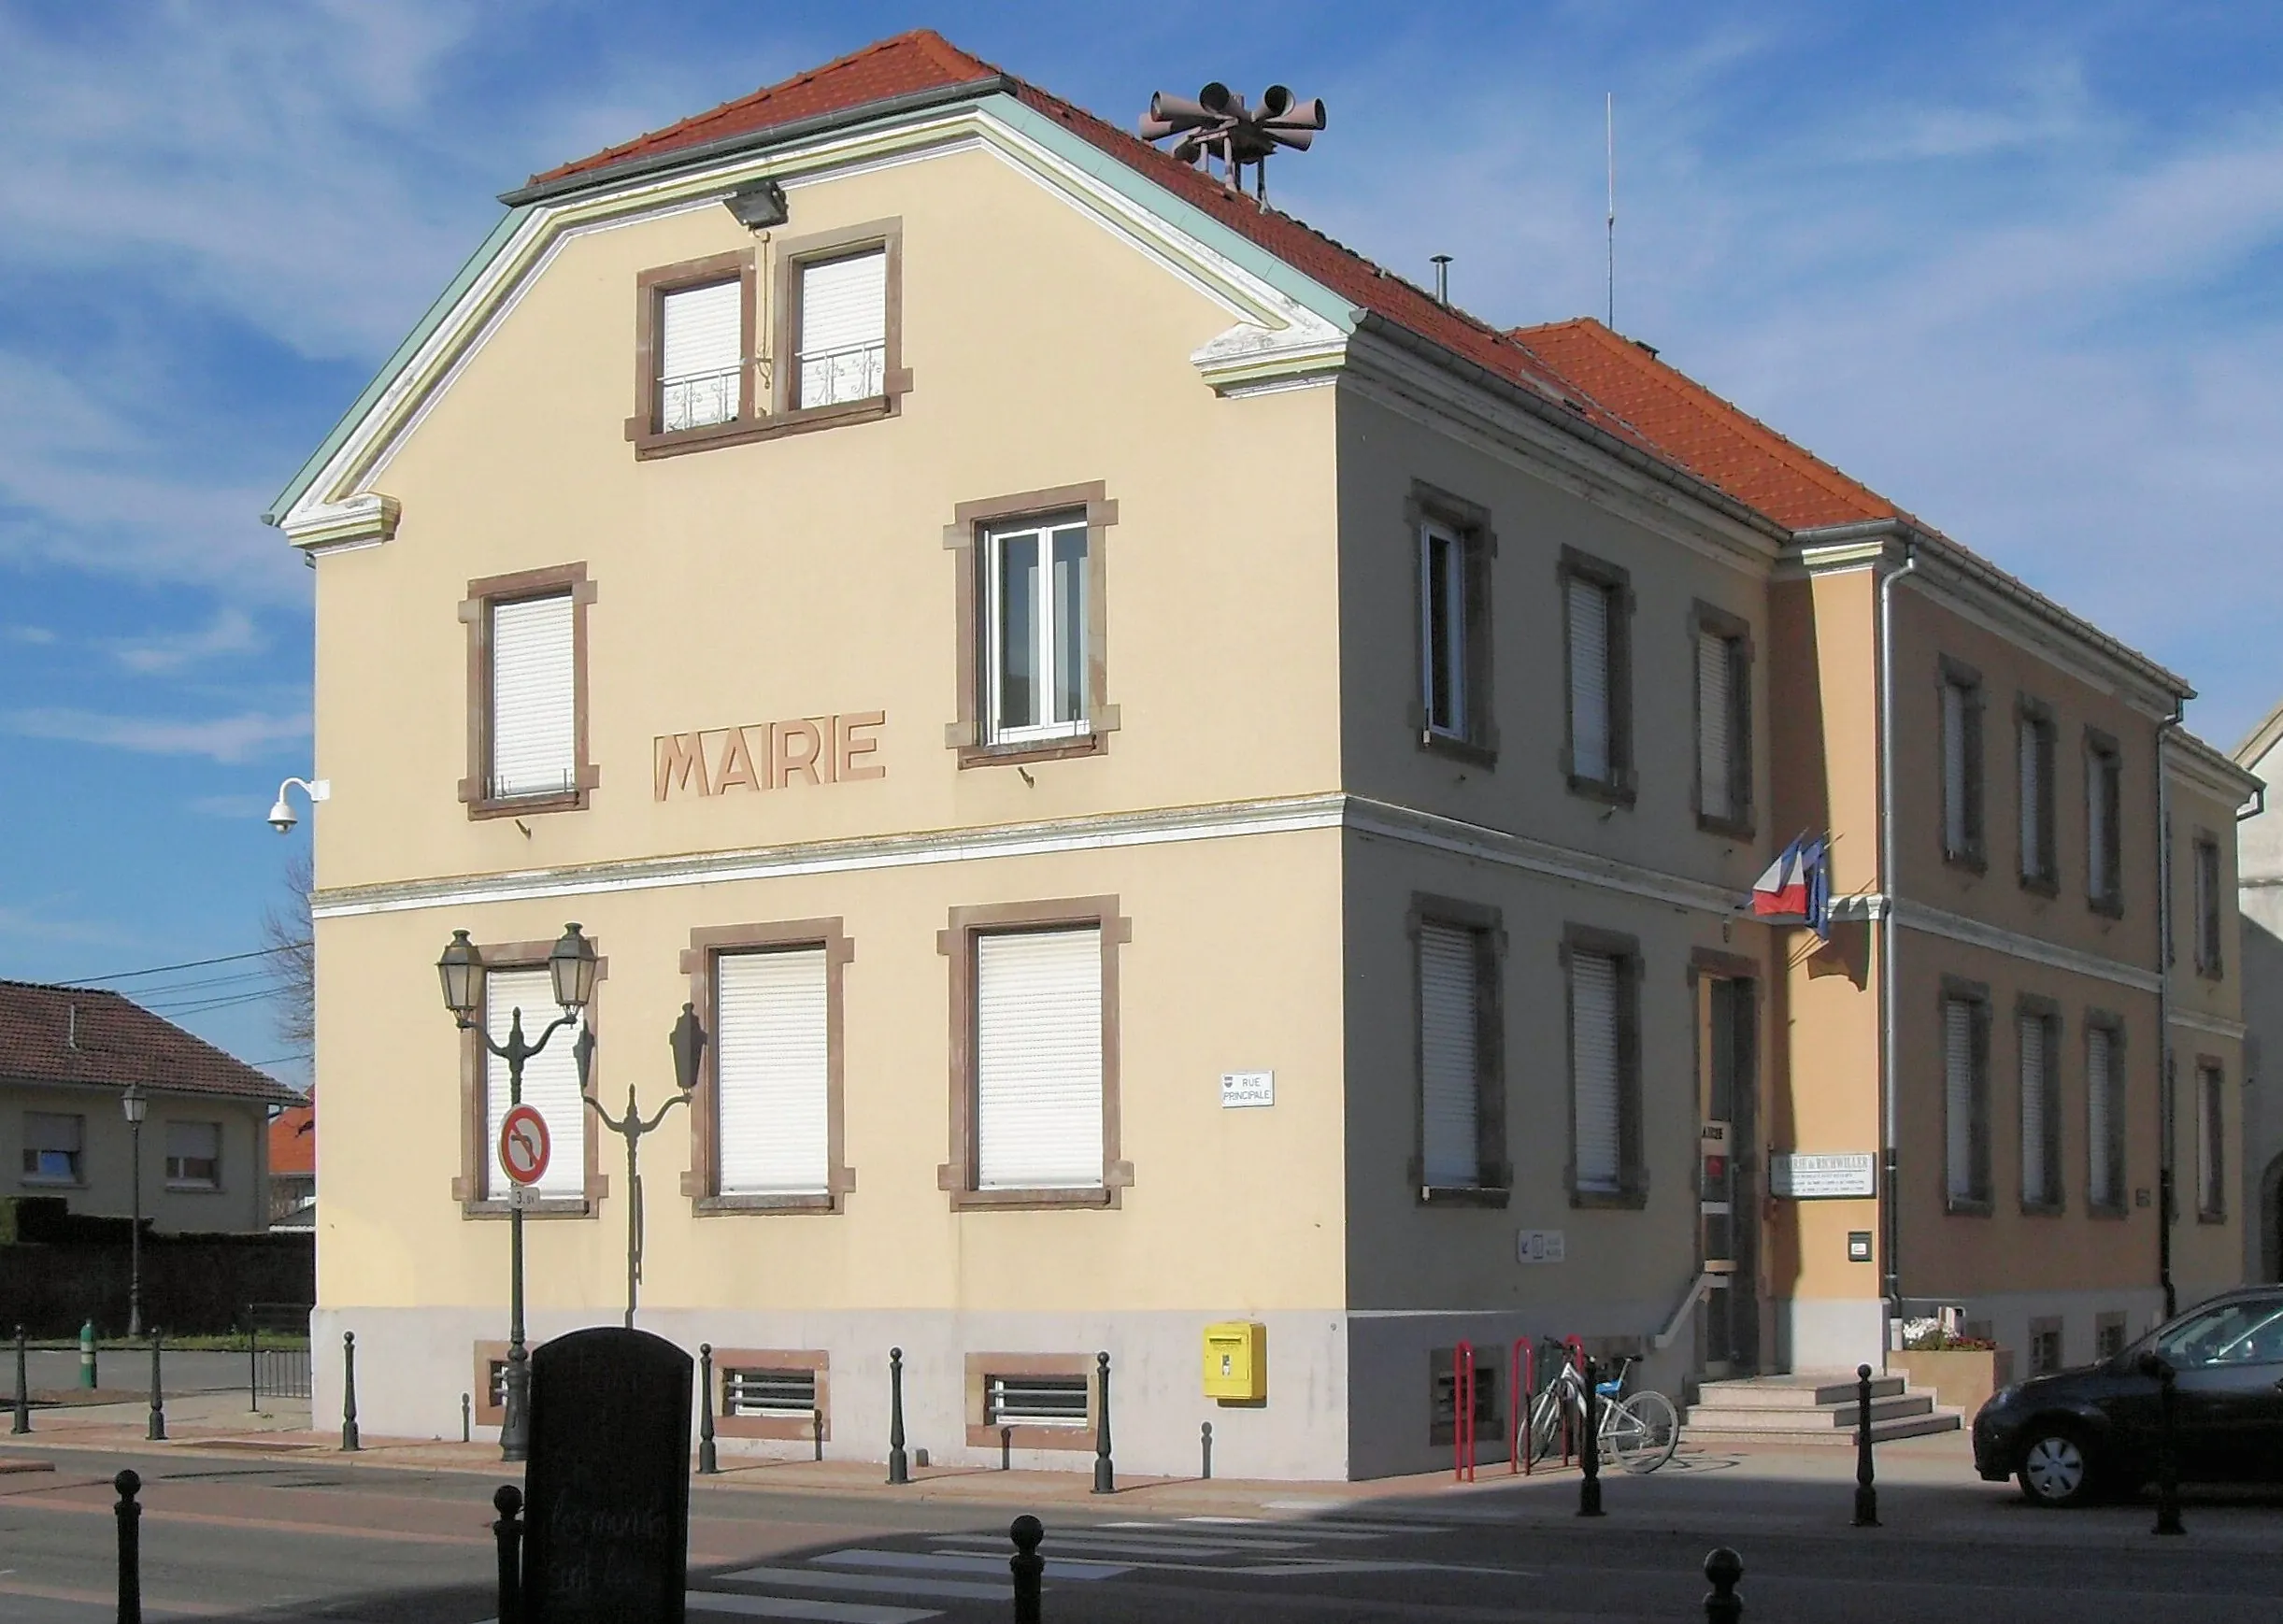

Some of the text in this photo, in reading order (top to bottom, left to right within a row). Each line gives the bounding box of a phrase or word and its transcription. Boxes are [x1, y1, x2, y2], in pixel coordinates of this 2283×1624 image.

[653, 709, 886, 802] MAIRIE
[1242, 1076, 1262, 1088] RUE
[1223, 1090, 1271, 1101] PRINCIPALE
